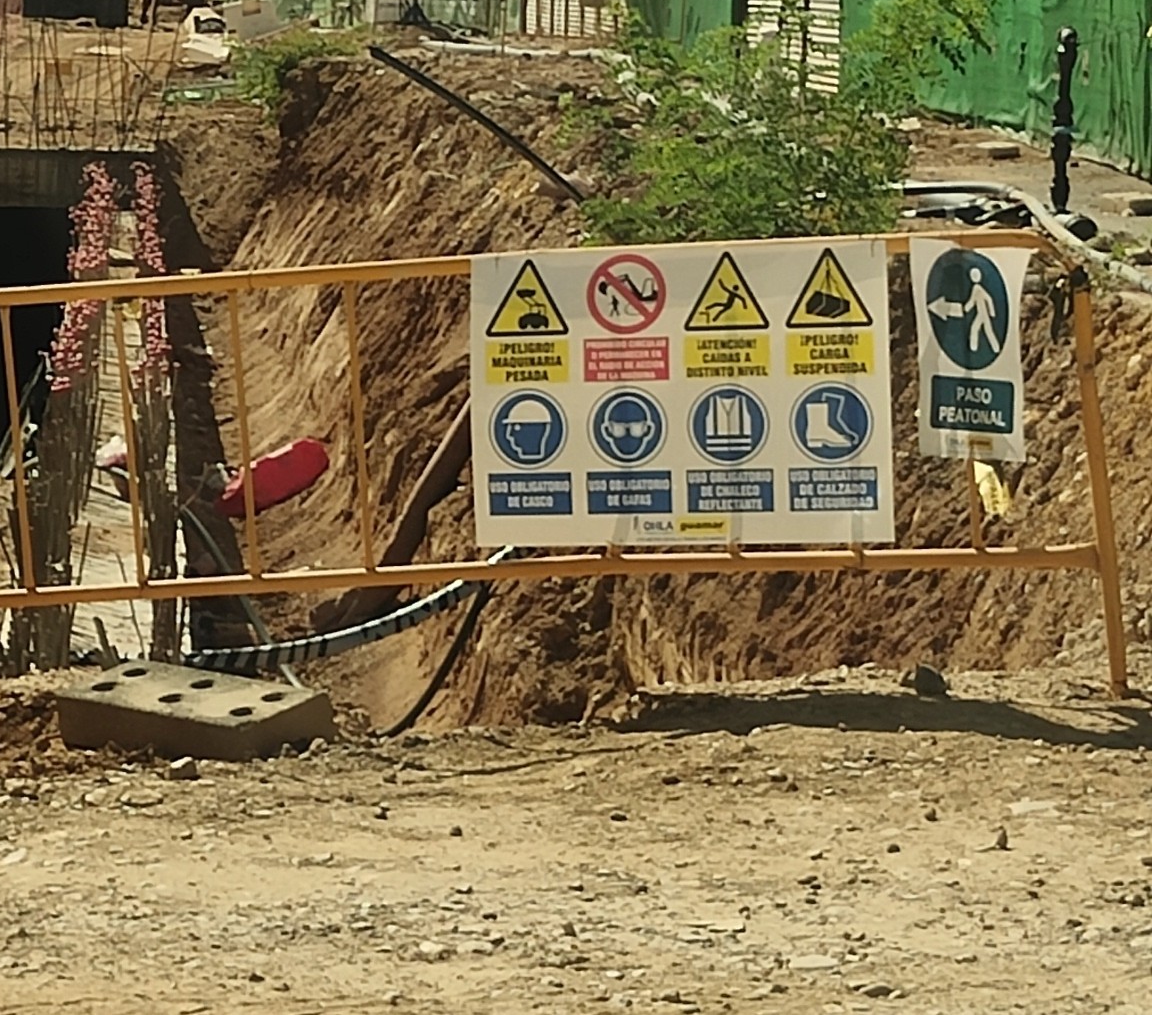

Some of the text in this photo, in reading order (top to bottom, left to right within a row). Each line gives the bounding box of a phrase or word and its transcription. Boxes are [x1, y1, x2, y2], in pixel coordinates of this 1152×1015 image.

[800, 334, 859, 347] ¡PELIGRO!
[500, 342, 555, 355] ¡PELIGRO!
[810, 347, 850, 360] CARGA
[492, 356, 562, 368] MAQUINARIA
[745, 353, 751, 363] A
[687, 365, 768, 378] DISTINTO NIVEL
[793, 362, 867, 375] SUSPENDIDA
[506, 370, 549, 382] PESADA
[956, 386, 992, 404] PASO
[938, 406, 1006, 427] PEATONAL
[709, 470, 772, 483] OBLIGATORIO
[811, 469, 875, 482] OBLIGATORIO
[510, 480, 570, 493] OBLIGATORIO
[609, 479, 669, 491] OBLIGATORIO
[701, 485, 760, 497] DE CHALECO
[799, 483, 867, 496] DE CALZADO
[508, 496, 554, 508] DE CASCO
[607, 494, 652, 507] DE GAFAS
[699, 498, 763, 510] REFLECTANTE
[794, 496, 874, 509] DE SEGURIDAD
